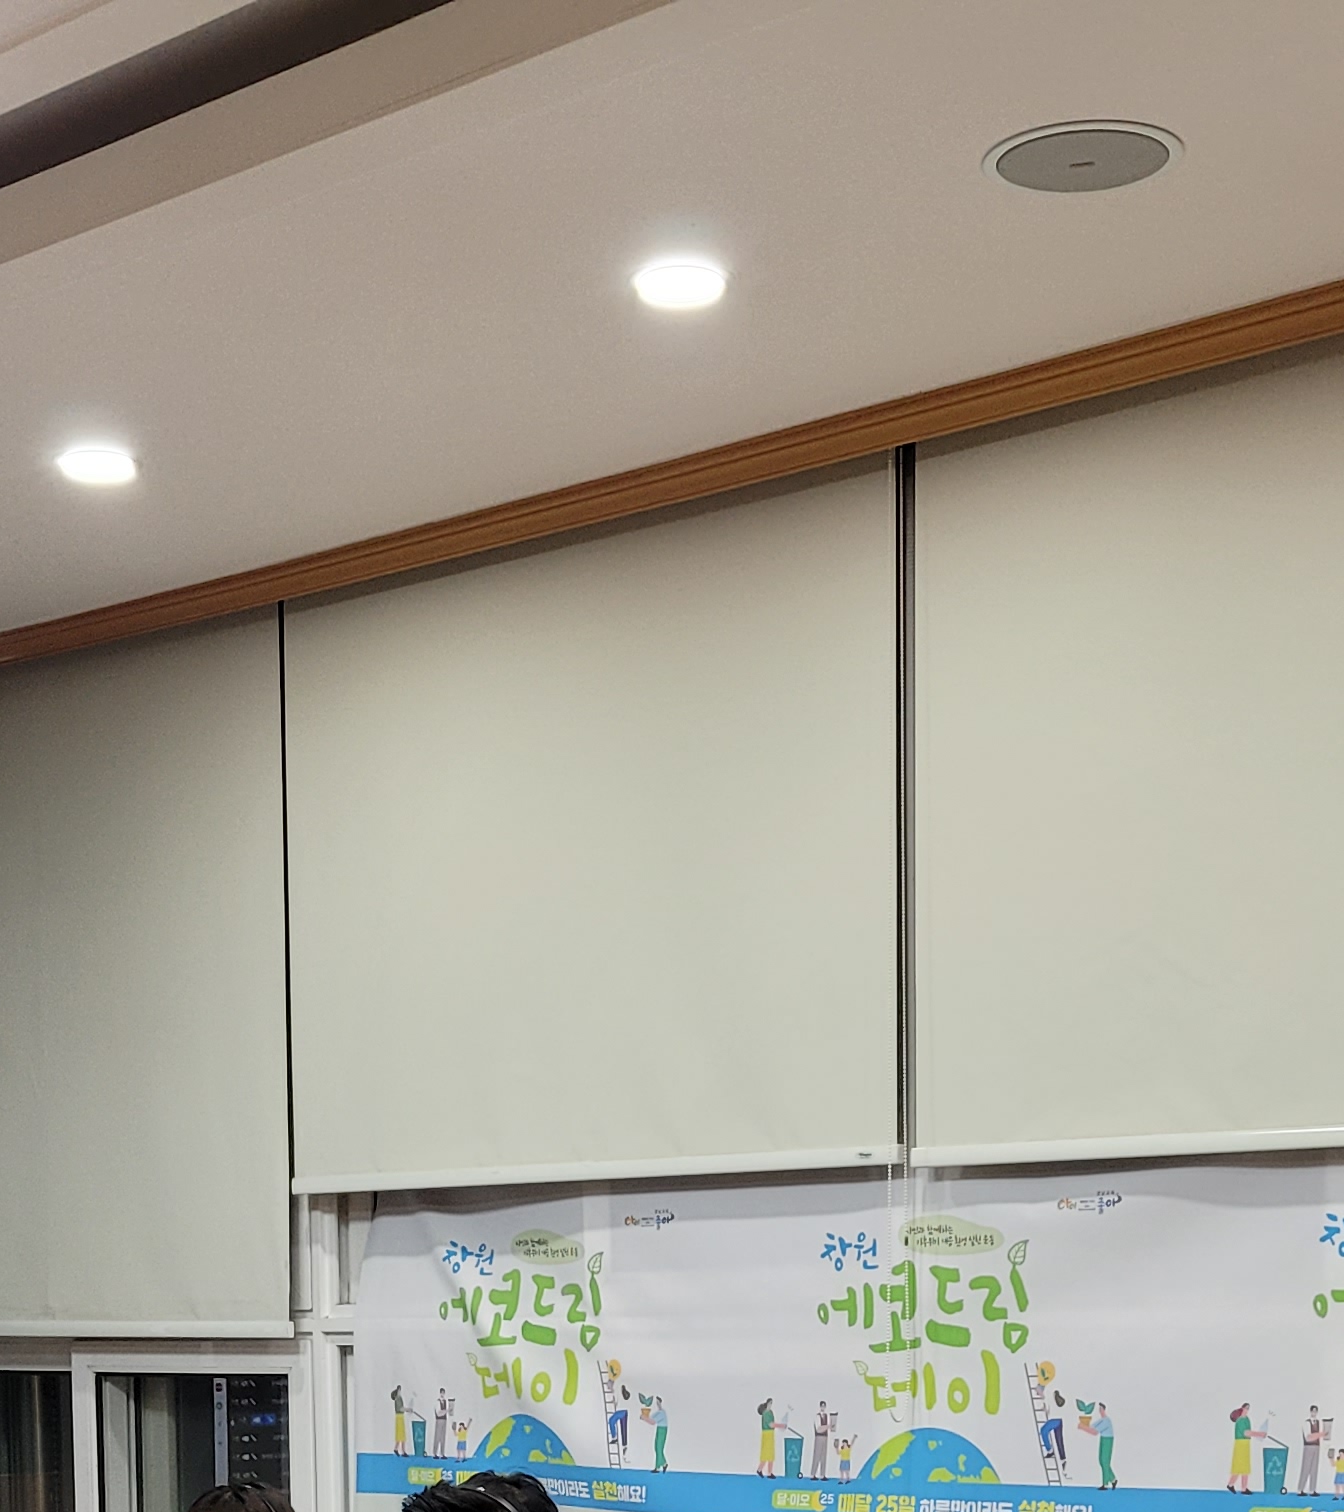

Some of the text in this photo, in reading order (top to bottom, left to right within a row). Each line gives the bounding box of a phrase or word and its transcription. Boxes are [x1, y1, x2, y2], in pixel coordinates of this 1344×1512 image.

[442, 1240, 494, 1275] 창원
[820, 1231, 879, 1272] 창원
[439, 1269, 602, 1353] 에코드림
[817, 1260, 1030, 1354] 에코드림
[476, 1349, 579, 1406] 데이
[864, 1349, 1001, 1414] 데이
[592, 1481, 647, 1503] 실천해요!
[820, 1494, 834, 1505] 25
